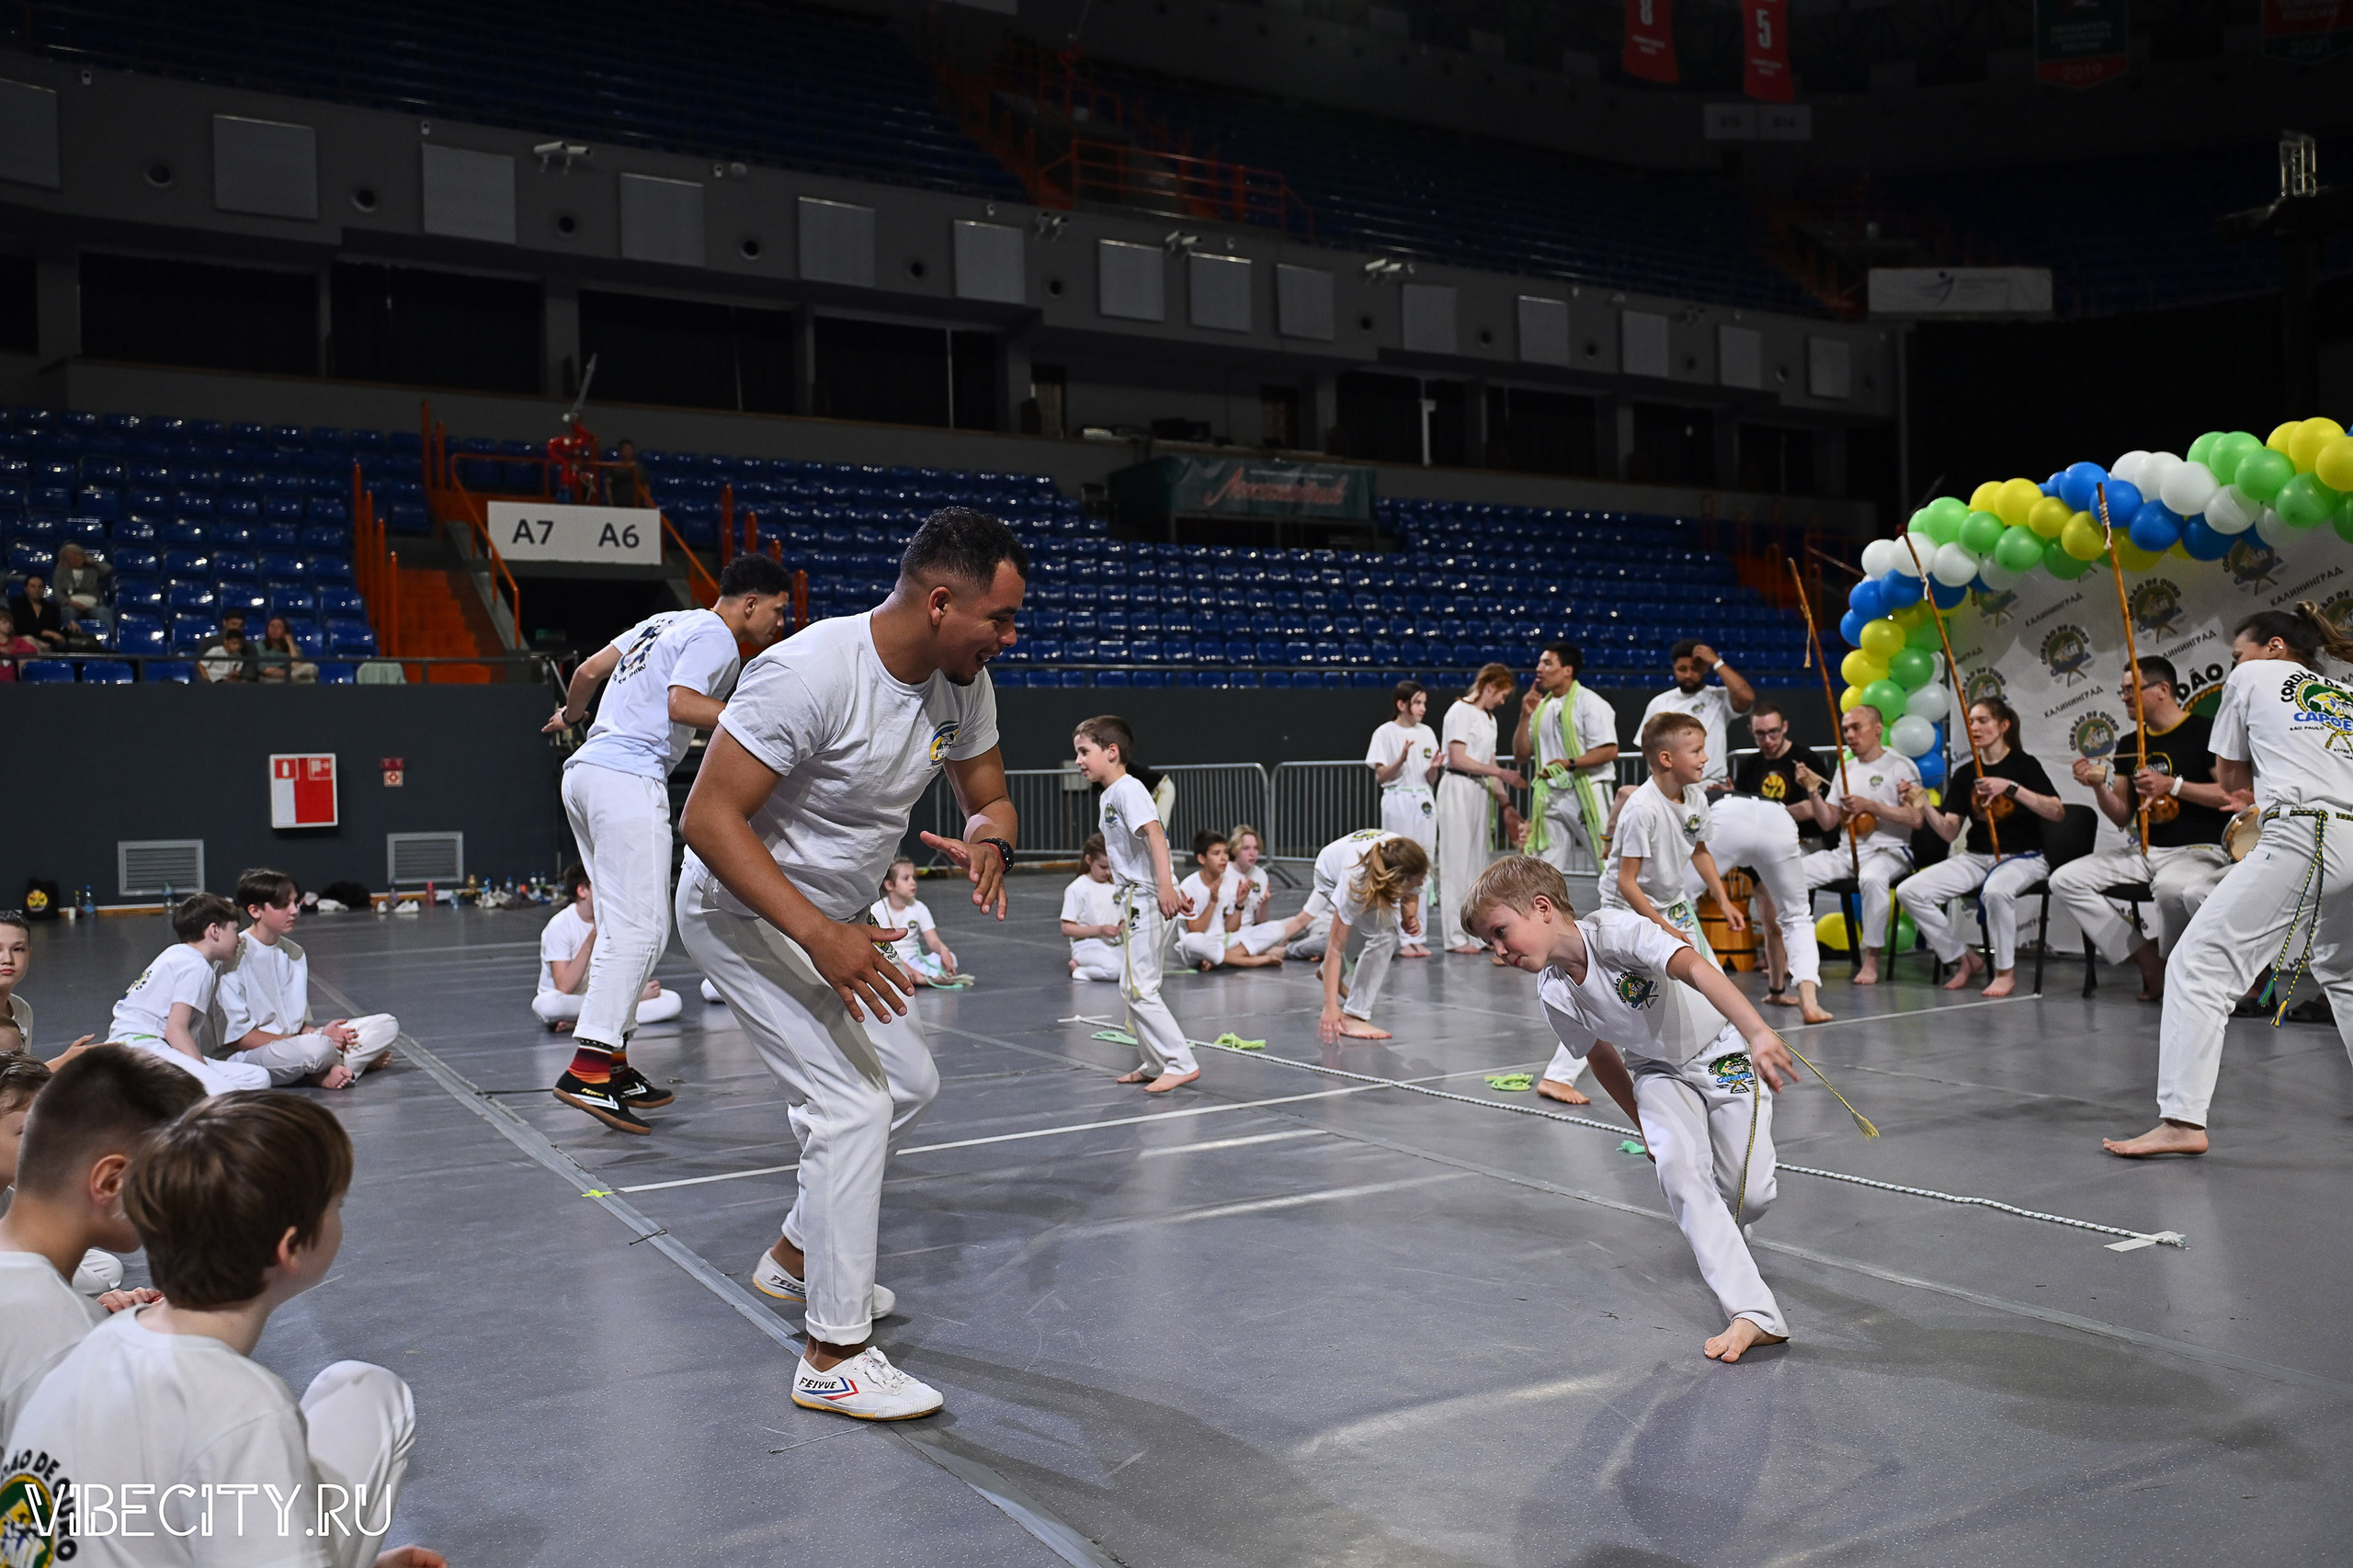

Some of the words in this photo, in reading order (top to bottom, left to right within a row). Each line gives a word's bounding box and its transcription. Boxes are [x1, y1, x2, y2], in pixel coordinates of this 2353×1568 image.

[1756, 8, 1772, 49] 5
[2062, 62, 2102, 80] 2019
[512, 518, 554, 545] A7
[598, 522, 640, 549] A6
[2270, 565, 2344, 608] КАЛИНИНГРАД
[2163, 629, 2217, 659] ЛИНИНГРАД
[2175, 663, 2224, 702] DÃO
[2044, 685, 2104, 719] КАЛИНИНГРАД
[799, 1377, 837, 1390] FEIYUE
[33, 1450, 61, 1483] DE
